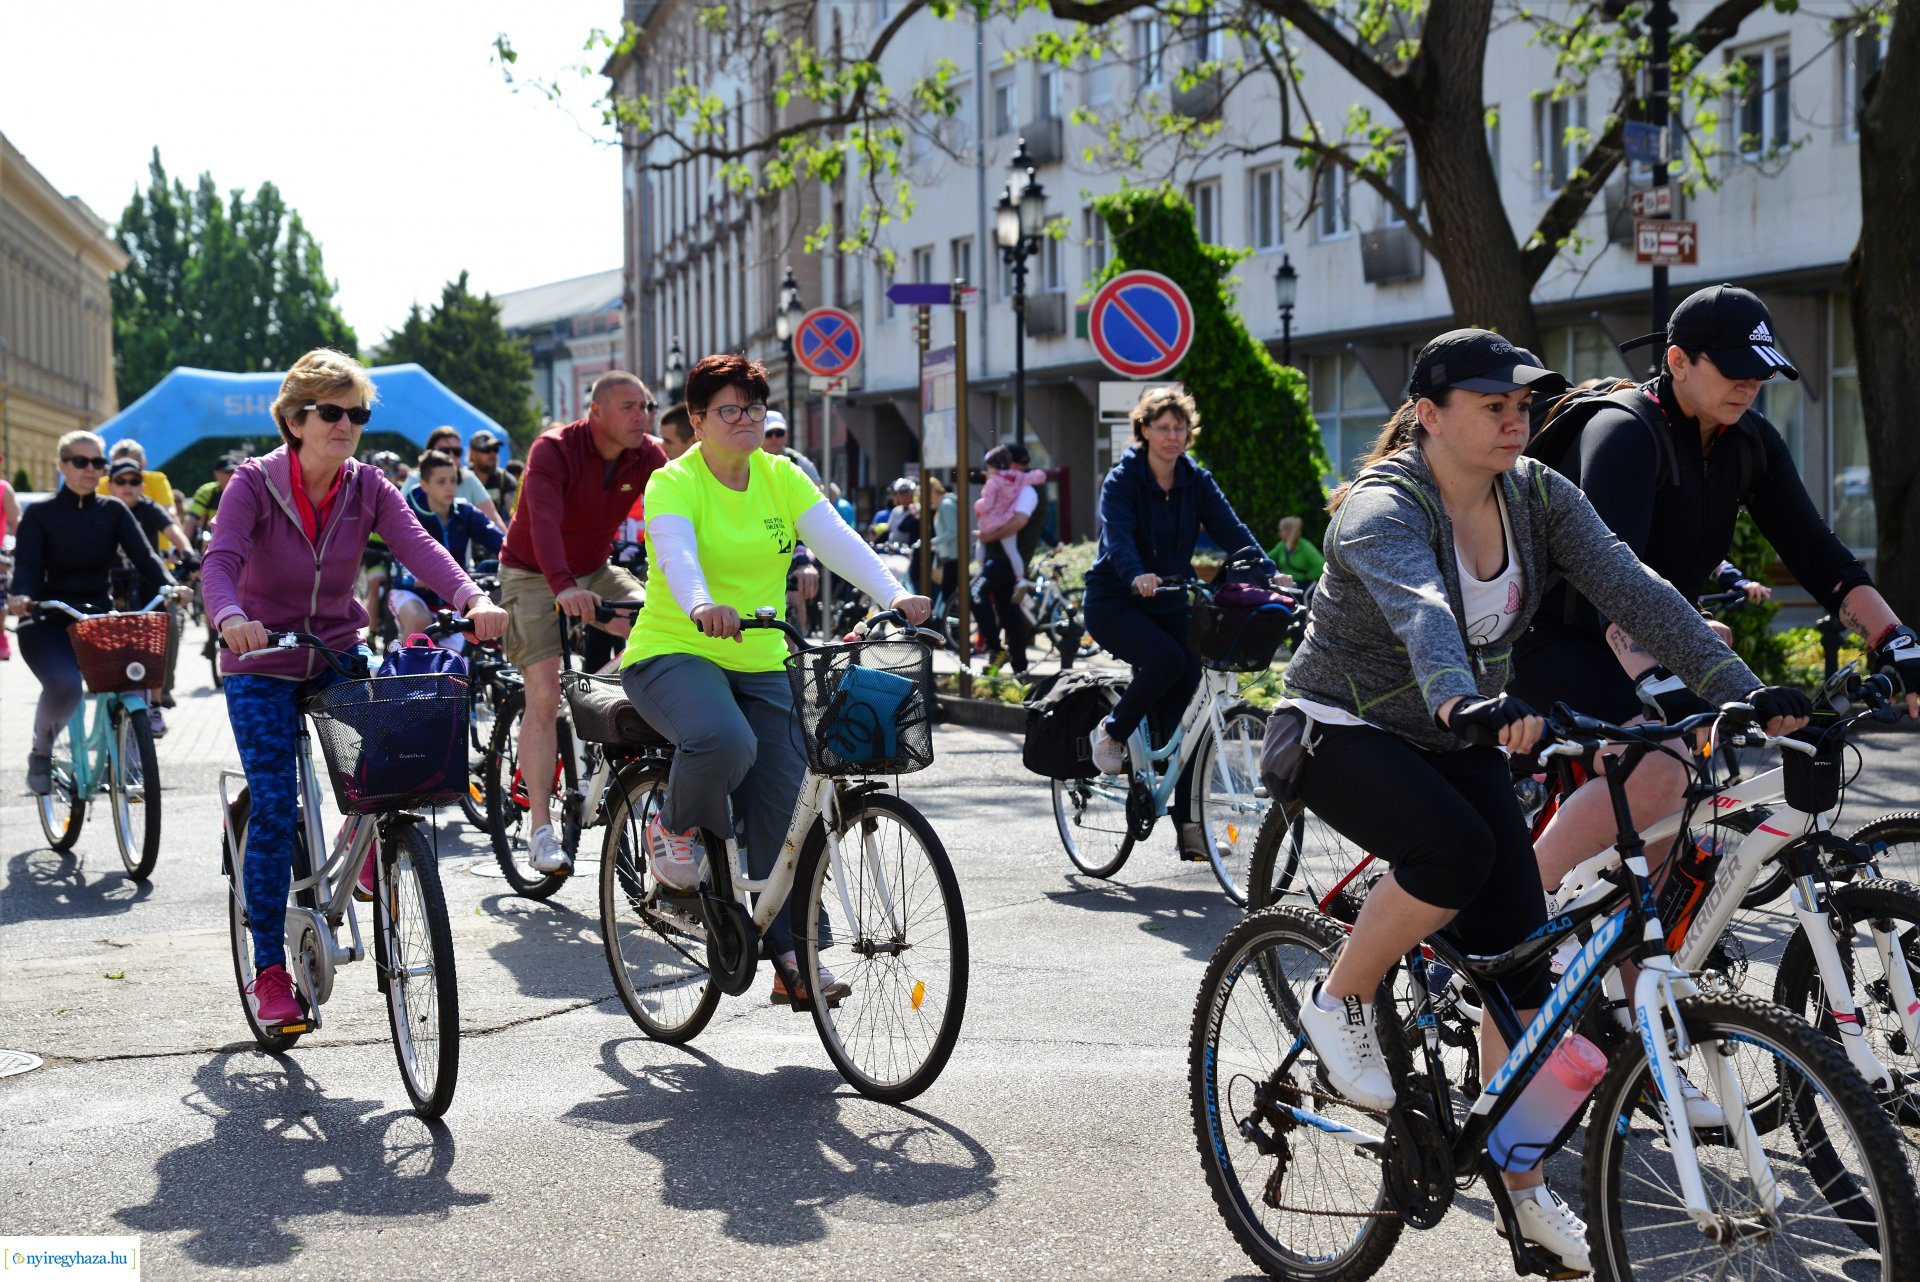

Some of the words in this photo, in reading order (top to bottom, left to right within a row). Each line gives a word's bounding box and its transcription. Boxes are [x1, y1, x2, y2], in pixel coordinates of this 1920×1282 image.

[1749, 333, 1773, 343] adidas
[1674, 854, 1742, 968] CKRIDER
[1495, 918, 1616, 1092] capriolo
